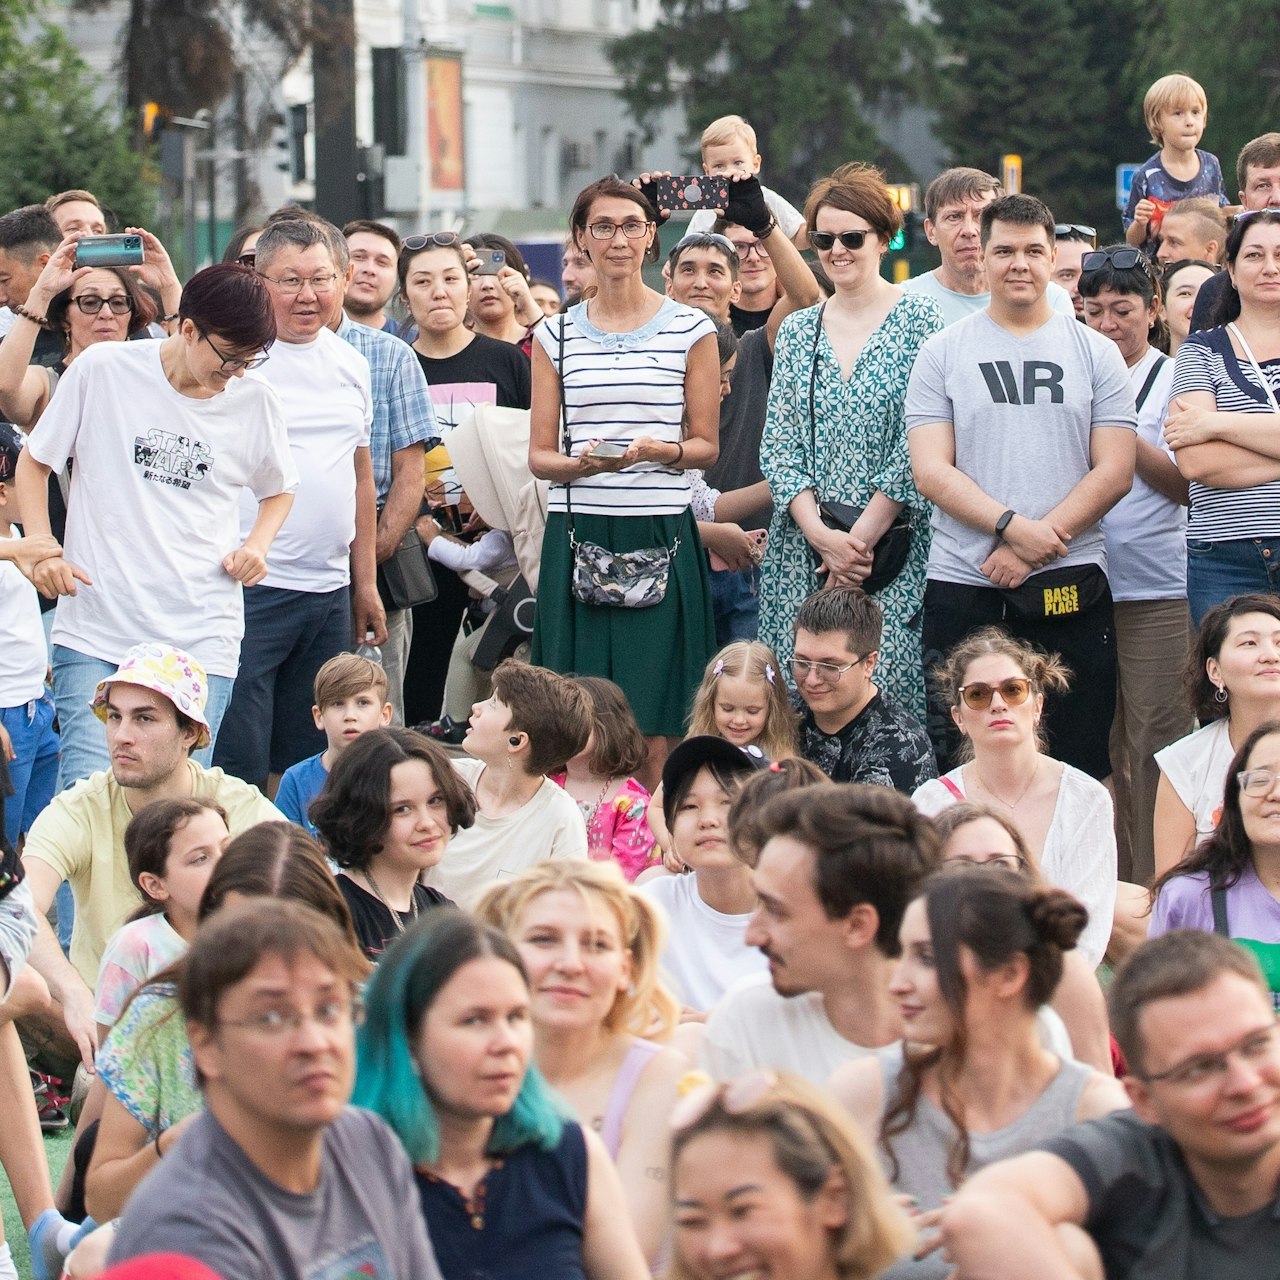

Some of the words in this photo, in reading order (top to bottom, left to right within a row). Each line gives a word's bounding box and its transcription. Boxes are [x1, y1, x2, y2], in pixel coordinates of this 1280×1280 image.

[135, 427, 214, 465] STAR
[134, 444, 212, 481] WARS
[1043, 584, 1078, 604] BASS
[1045, 599, 1079, 616] PLACE
